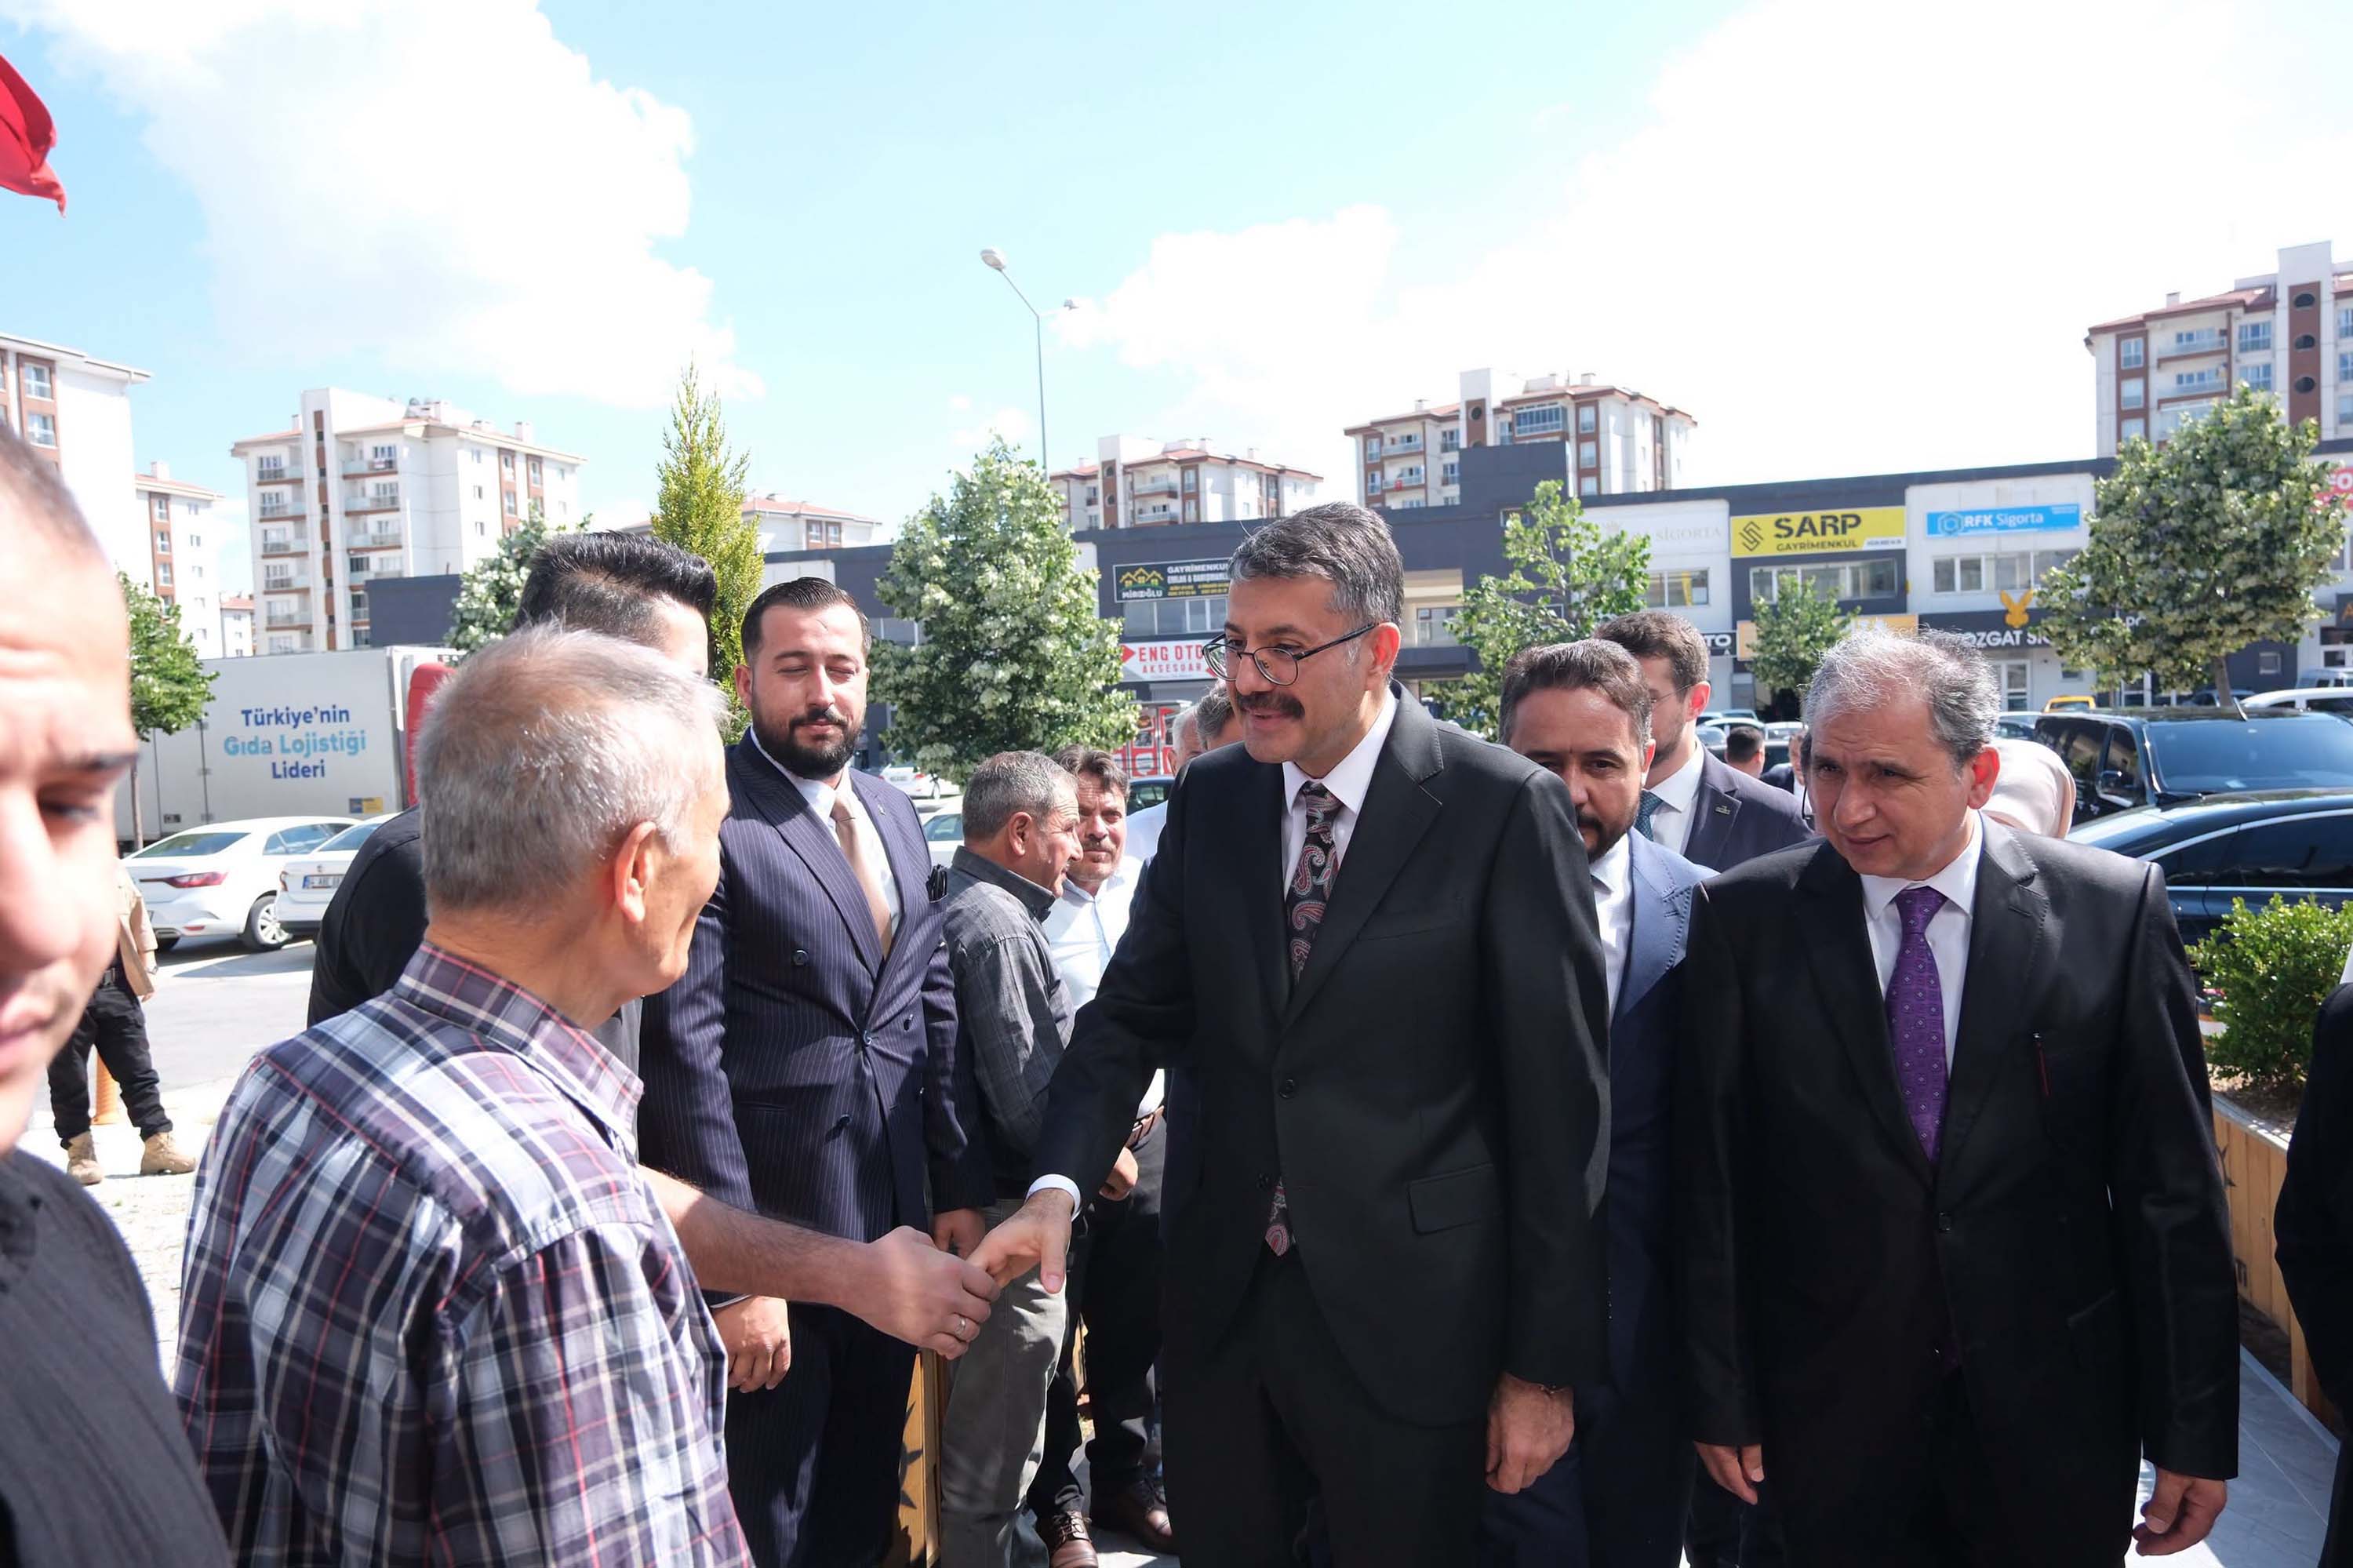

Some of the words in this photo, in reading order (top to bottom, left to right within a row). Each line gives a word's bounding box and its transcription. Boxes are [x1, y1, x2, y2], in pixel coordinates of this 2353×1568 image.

[1773, 514, 1861, 539] SARP
[1964, 514, 1994, 528] RFK
[1996, 512, 2044, 528] Sigorta
[1776, 539, 1858, 552] GAYRİMENKUL
[1960, 630, 2023, 648] OZGAT
[1138, 646, 1169, 662] ENG
[241, 704, 351, 729] Türkiye'nin
[224, 736, 273, 756] Gıda
[278, 729, 367, 759] Lojistiği
[271, 759, 325, 780] Lideri
